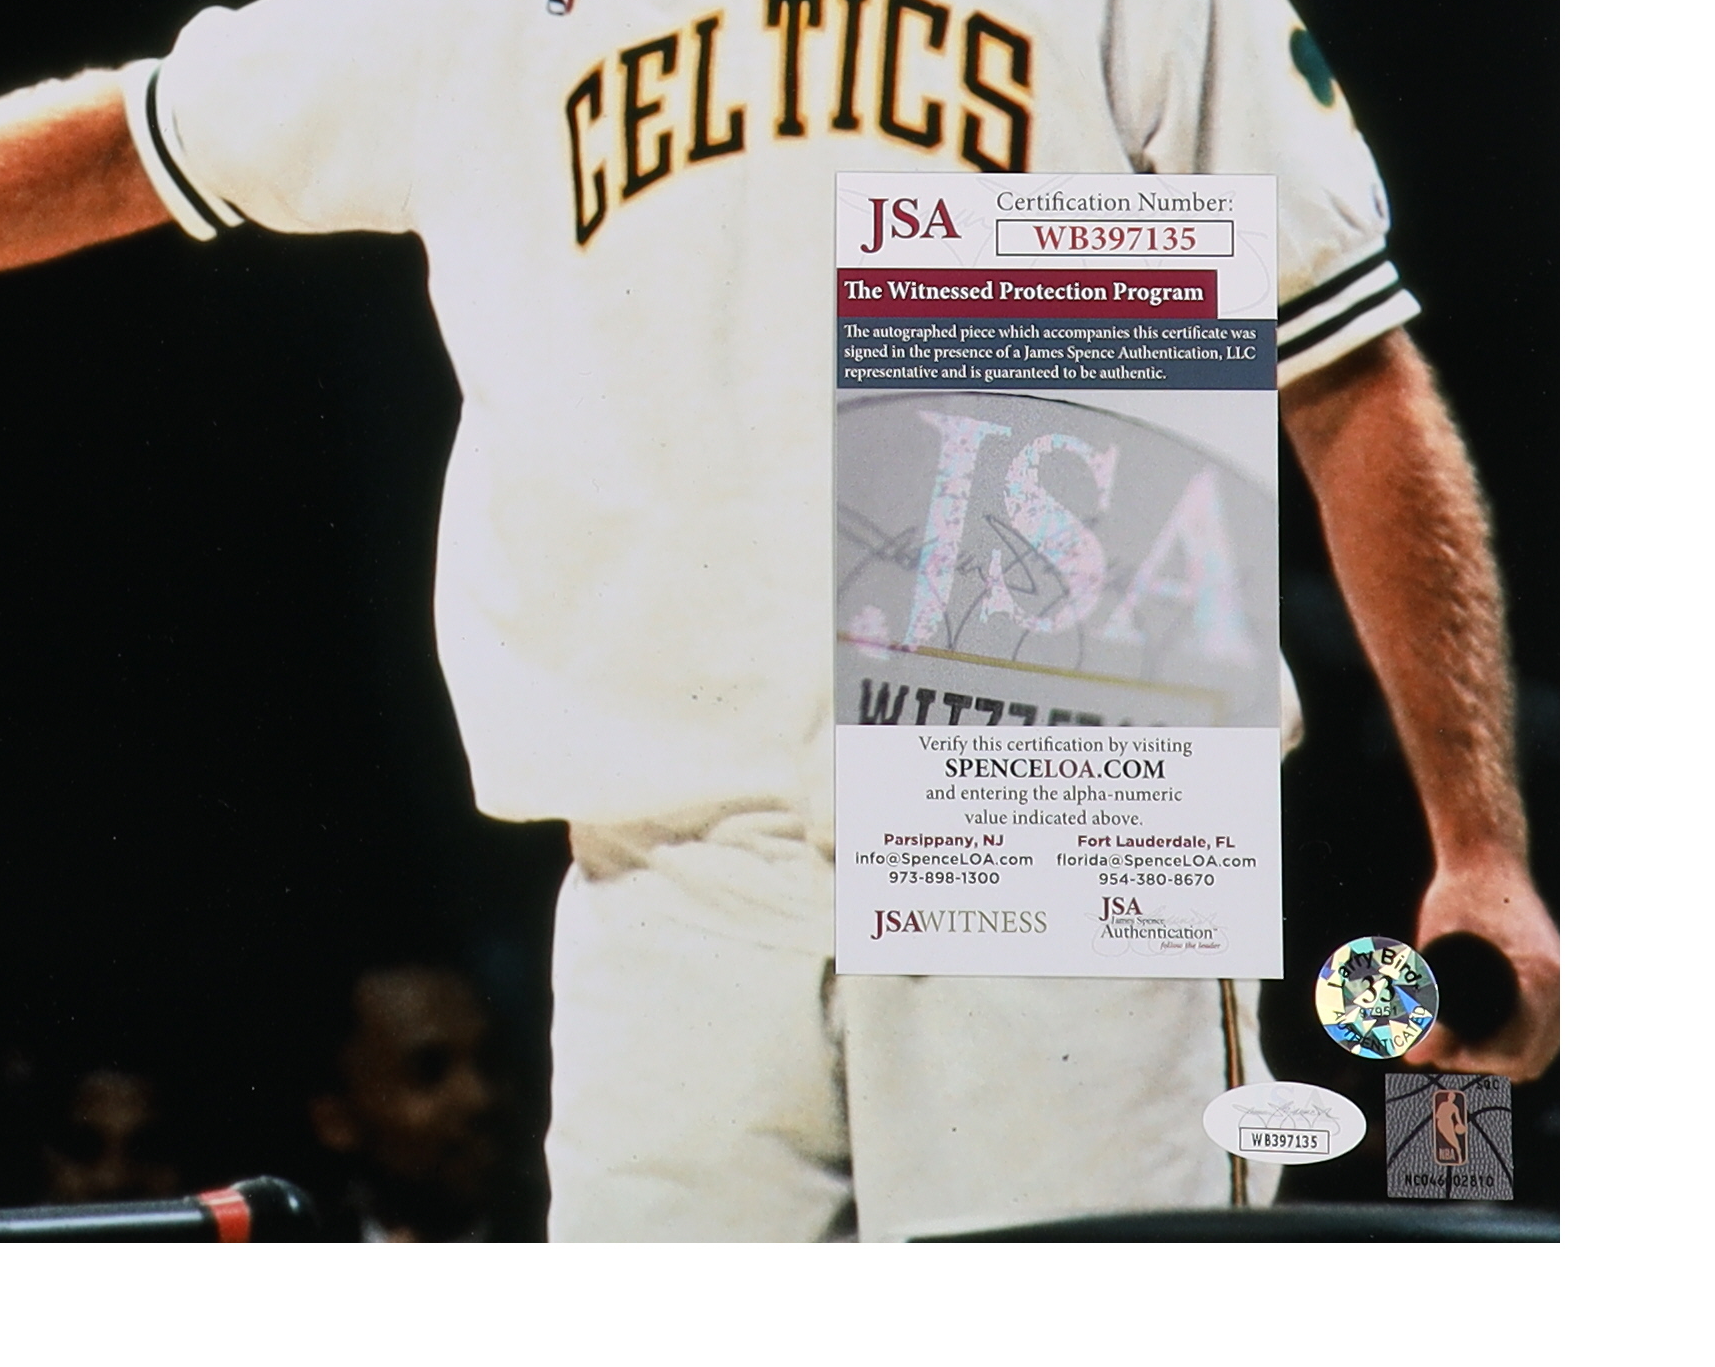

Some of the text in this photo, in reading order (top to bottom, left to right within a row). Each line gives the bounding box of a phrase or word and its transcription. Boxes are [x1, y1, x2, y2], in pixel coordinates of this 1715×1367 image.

[996, 192, 1234, 213] Certification Number:
[860, 197, 962, 254] JSA
[1032, 225, 1197, 251] WB397135
[844, 280, 1204, 307] The Witnessed Protection Program
[844, 324, 1257, 343] The autographed piece which accompanies this certificate was
[844, 344, 1257, 362] signed in the presence of a James Spence Authentication, LLC
[844, 365, 1167, 382] representative and is guaranteed to be authentic.
[919, 735, 1193, 757] Verify this certification by visiting
[945, 758, 1166, 779] SPENCELOA.COM
[926, 784, 1182, 805] and entering the alpha-numeric
[965, 809, 1143, 826] value indicated above.
[884, 833, 1004, 848] Parsippany, NJ
[1078, 835, 1235, 850] Fort Lauderdale, FL
[855, 852, 1034, 867] info@SpenceLOA.com
[1057, 853, 1257, 868] florida@SpenceLOA.com
[889, 871, 1000, 884] 973-898-1300
[1098, 873, 1215, 886] 954-380-8670
[1098, 896, 1143, 922] JSA
[1327, 951, 1374, 988] Larry
[1361, 975, 1395, 1003] 33
[1251, 1132, 1318, 1149] WB397135
[1438, 1148, 1456, 1161] NBA
